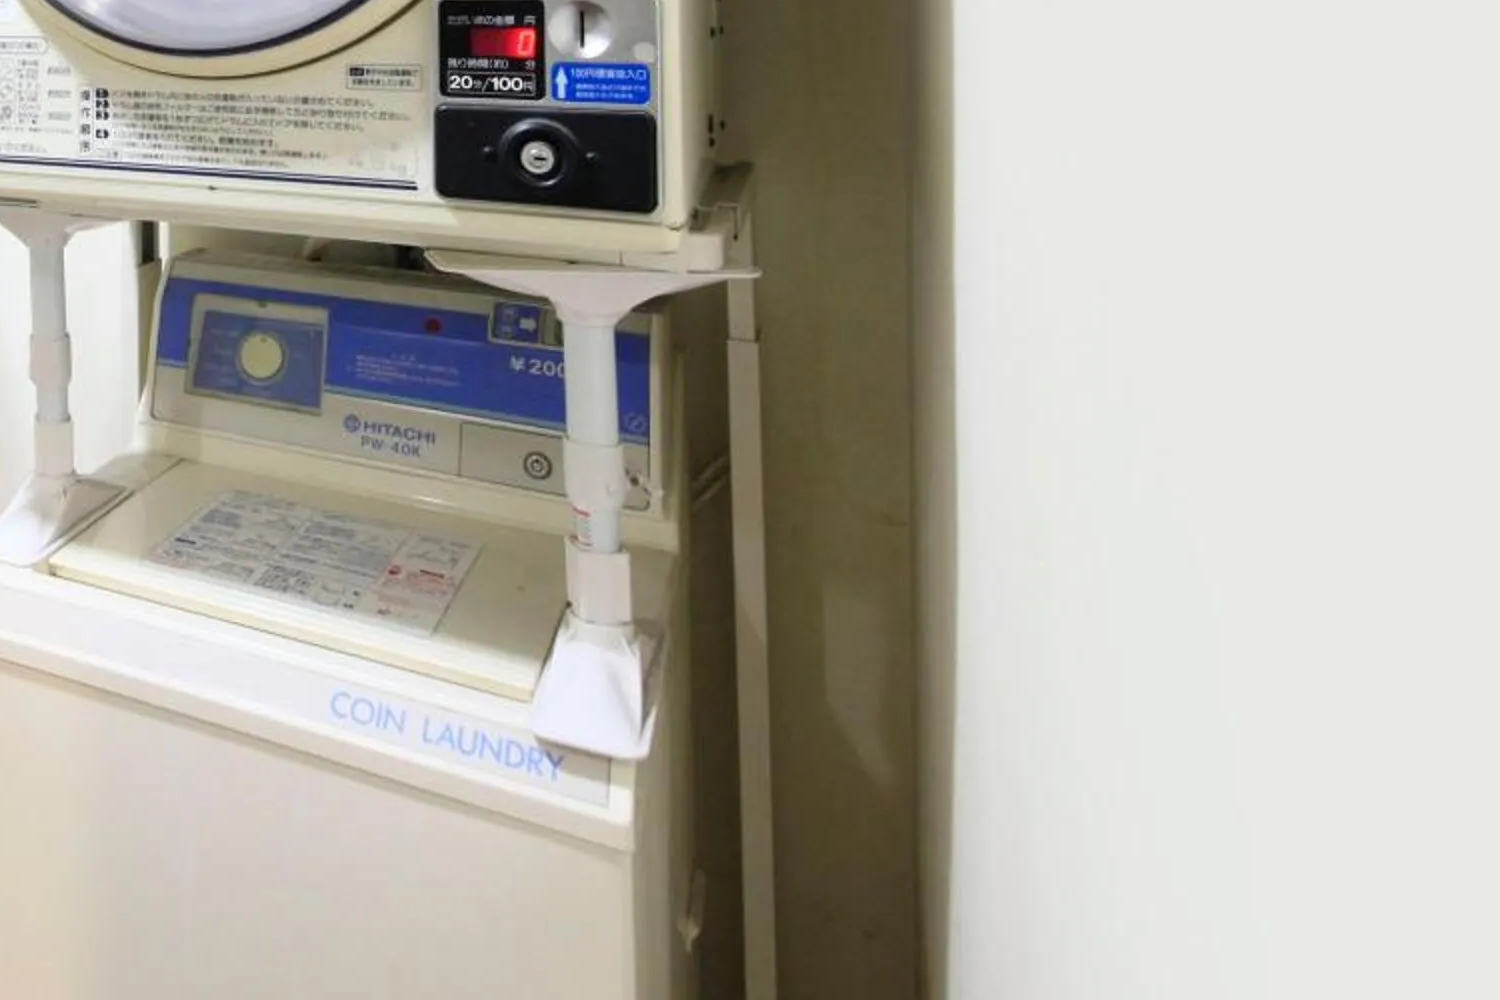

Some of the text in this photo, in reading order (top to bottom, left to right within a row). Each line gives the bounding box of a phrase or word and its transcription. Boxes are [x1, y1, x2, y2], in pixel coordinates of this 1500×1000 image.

[517, 28, 536, 58] 0
[362, 421, 437, 445] HITACHI
[329, 690, 564, 782] COIN LAUNDRY
